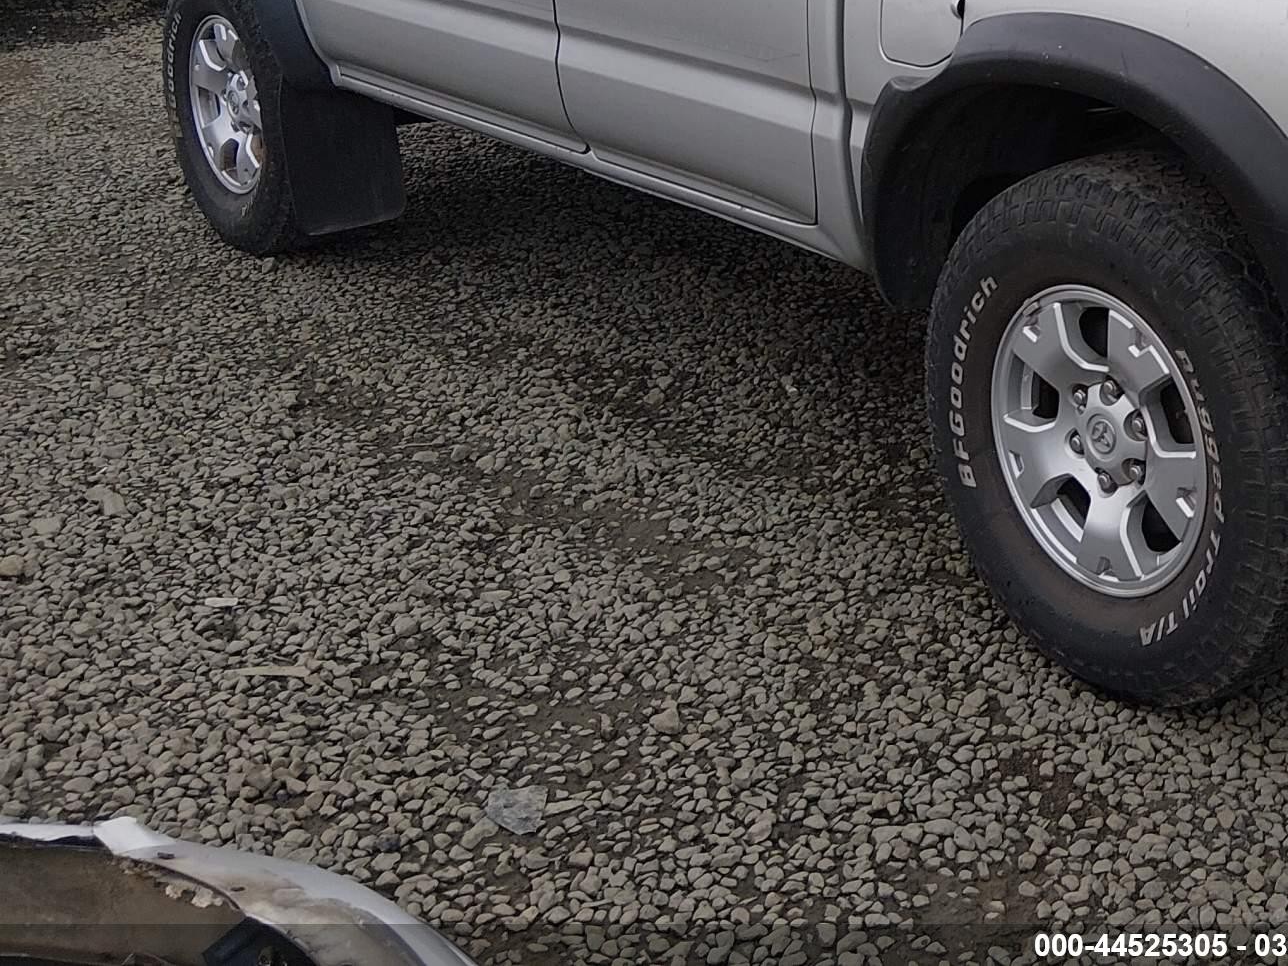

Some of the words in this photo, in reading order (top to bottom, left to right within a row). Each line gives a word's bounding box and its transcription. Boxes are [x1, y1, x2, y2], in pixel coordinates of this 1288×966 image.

[949, 275, 998, 488] BFGoodrich
[1181, 529, 1221, 620] Trail
[1139, 610, 1178, 647] T/A
